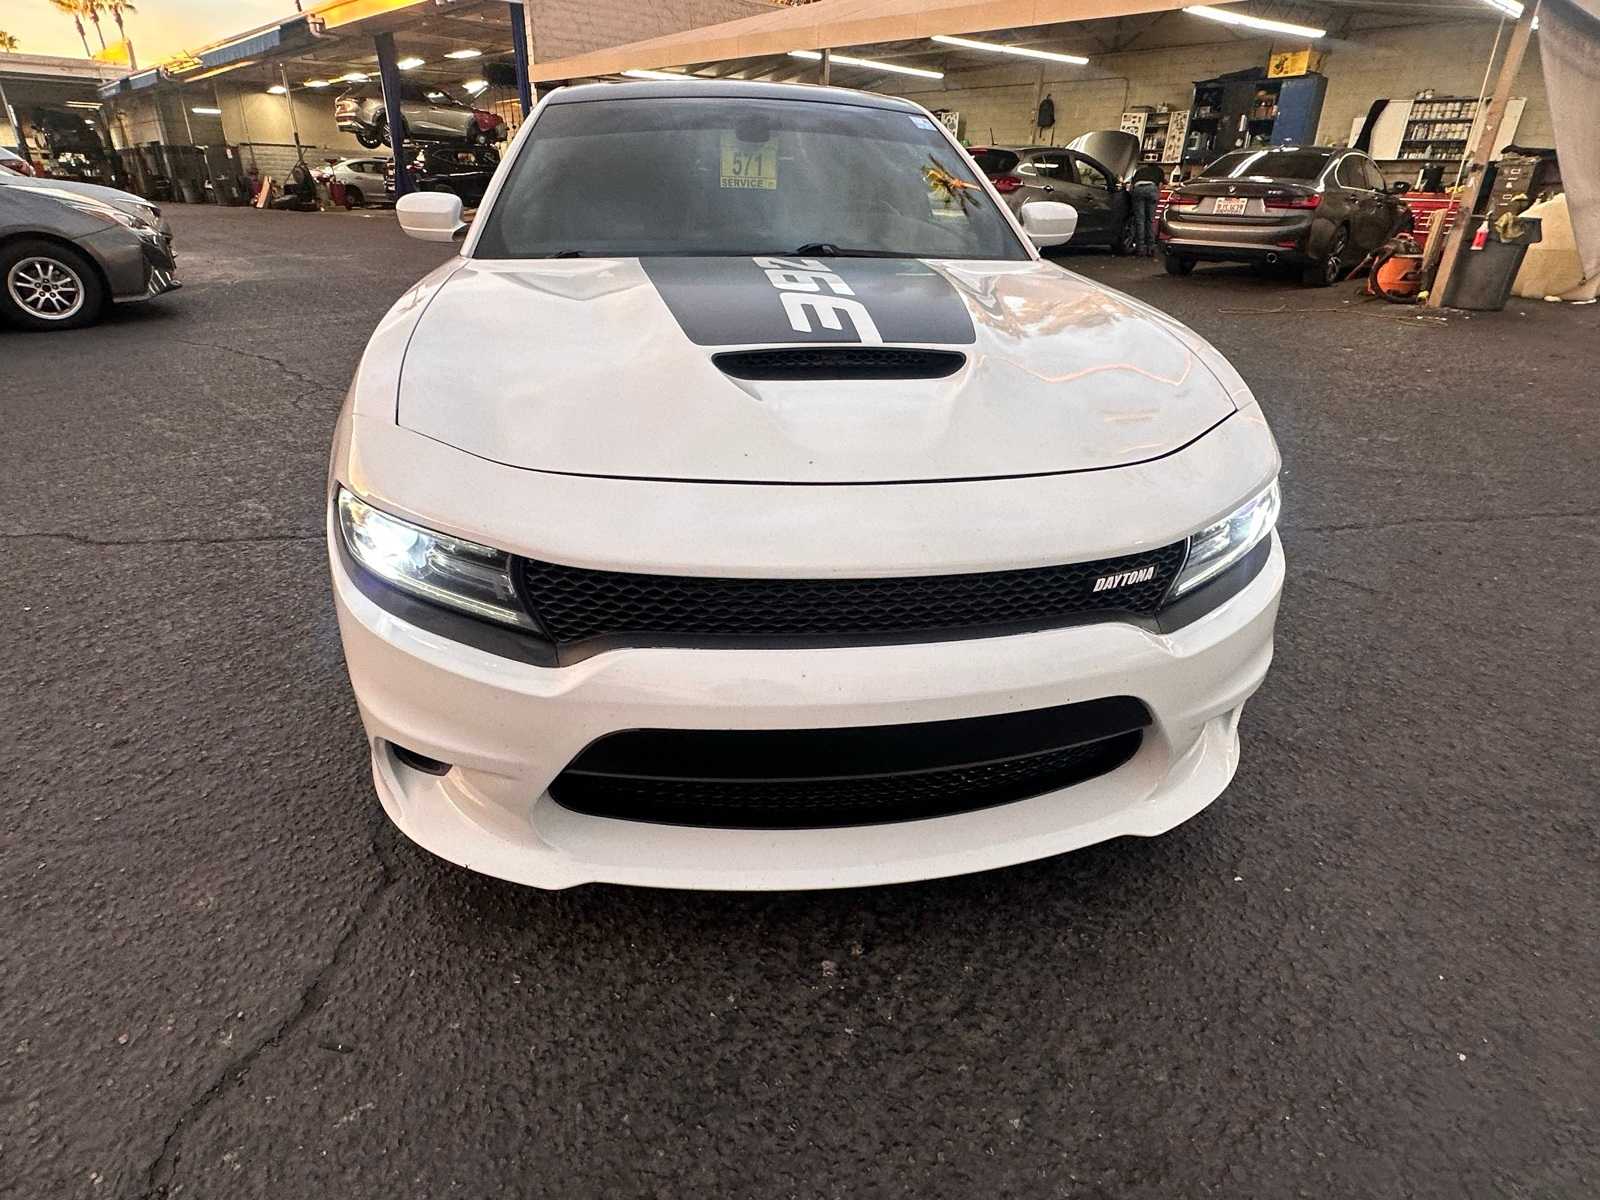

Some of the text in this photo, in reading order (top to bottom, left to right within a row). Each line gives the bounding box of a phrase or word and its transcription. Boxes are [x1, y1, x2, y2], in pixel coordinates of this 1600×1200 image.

[732, 152, 762, 176] 571
[721, 178, 764, 188] SERVICE
[1093, 566, 1154, 592] DAYTONA
